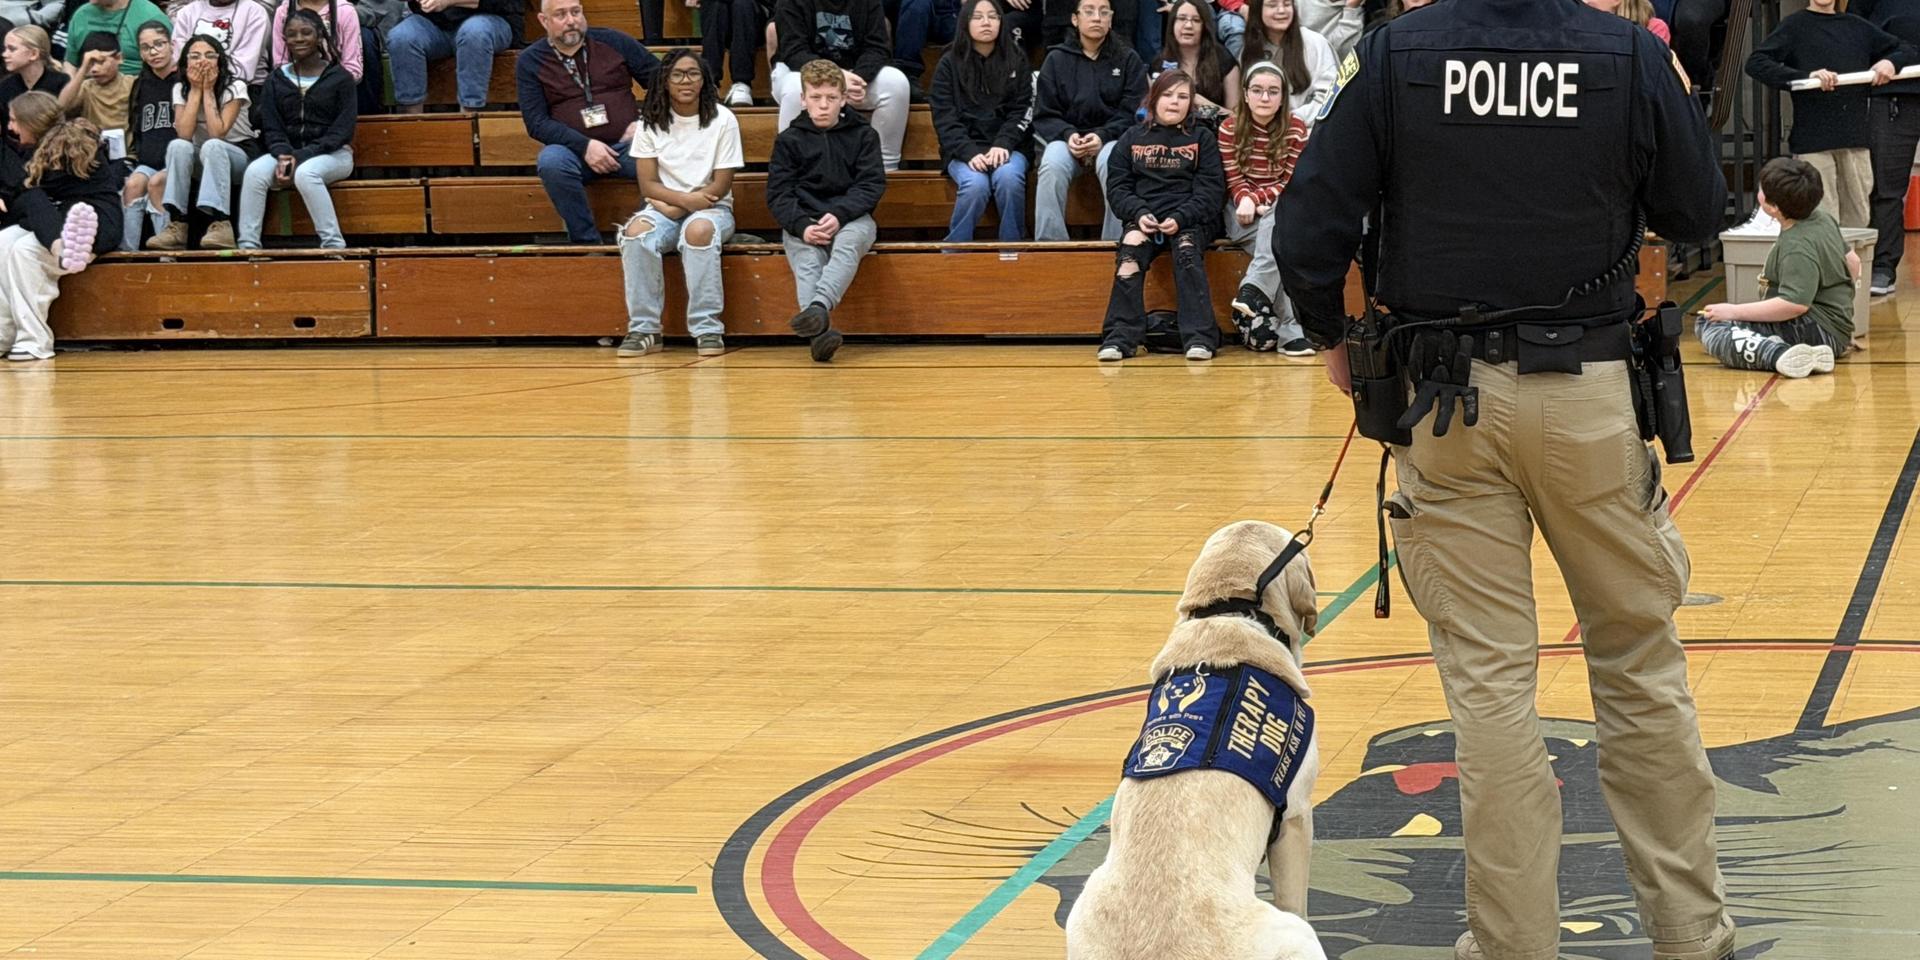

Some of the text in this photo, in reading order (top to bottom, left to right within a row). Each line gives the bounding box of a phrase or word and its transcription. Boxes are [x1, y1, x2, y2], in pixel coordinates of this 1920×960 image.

[1444, 60, 1579, 118] POLICE
[141, 101, 176, 132] GA
[1145, 726, 1191, 744] POLICE
[1227, 675, 1270, 759] THERAPY
[1259, 712, 1289, 755] DOG
[1273, 702, 1306, 788] PLEASE ASK TO PET
